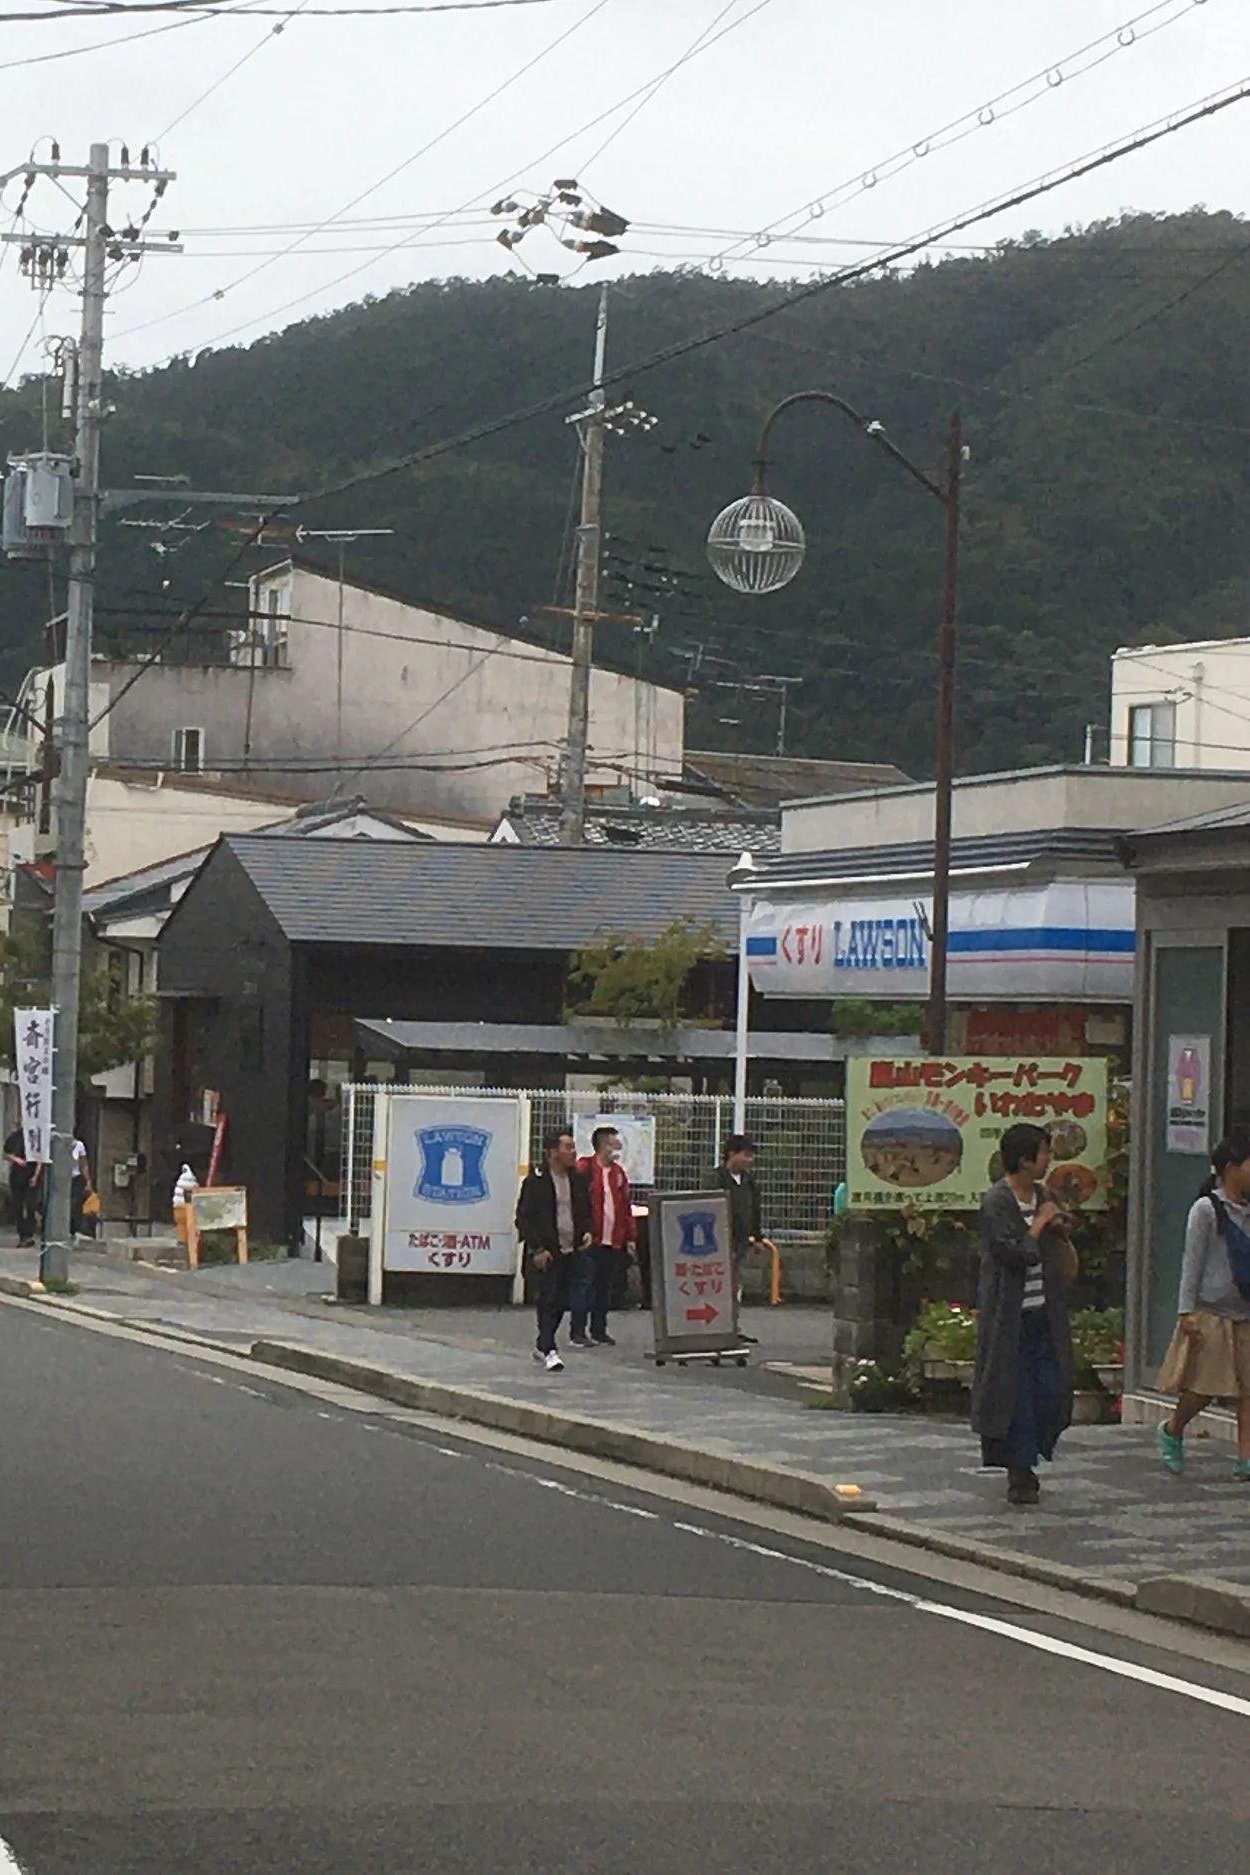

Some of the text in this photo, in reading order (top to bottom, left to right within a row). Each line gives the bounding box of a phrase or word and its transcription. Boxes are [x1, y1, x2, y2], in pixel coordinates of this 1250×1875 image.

[781, 924, 823, 966] くすり
[833, 918, 926, 969] LAWSON
[428, 1252, 471, 1268] くすり
[678, 1281, 723, 1297] くすり
